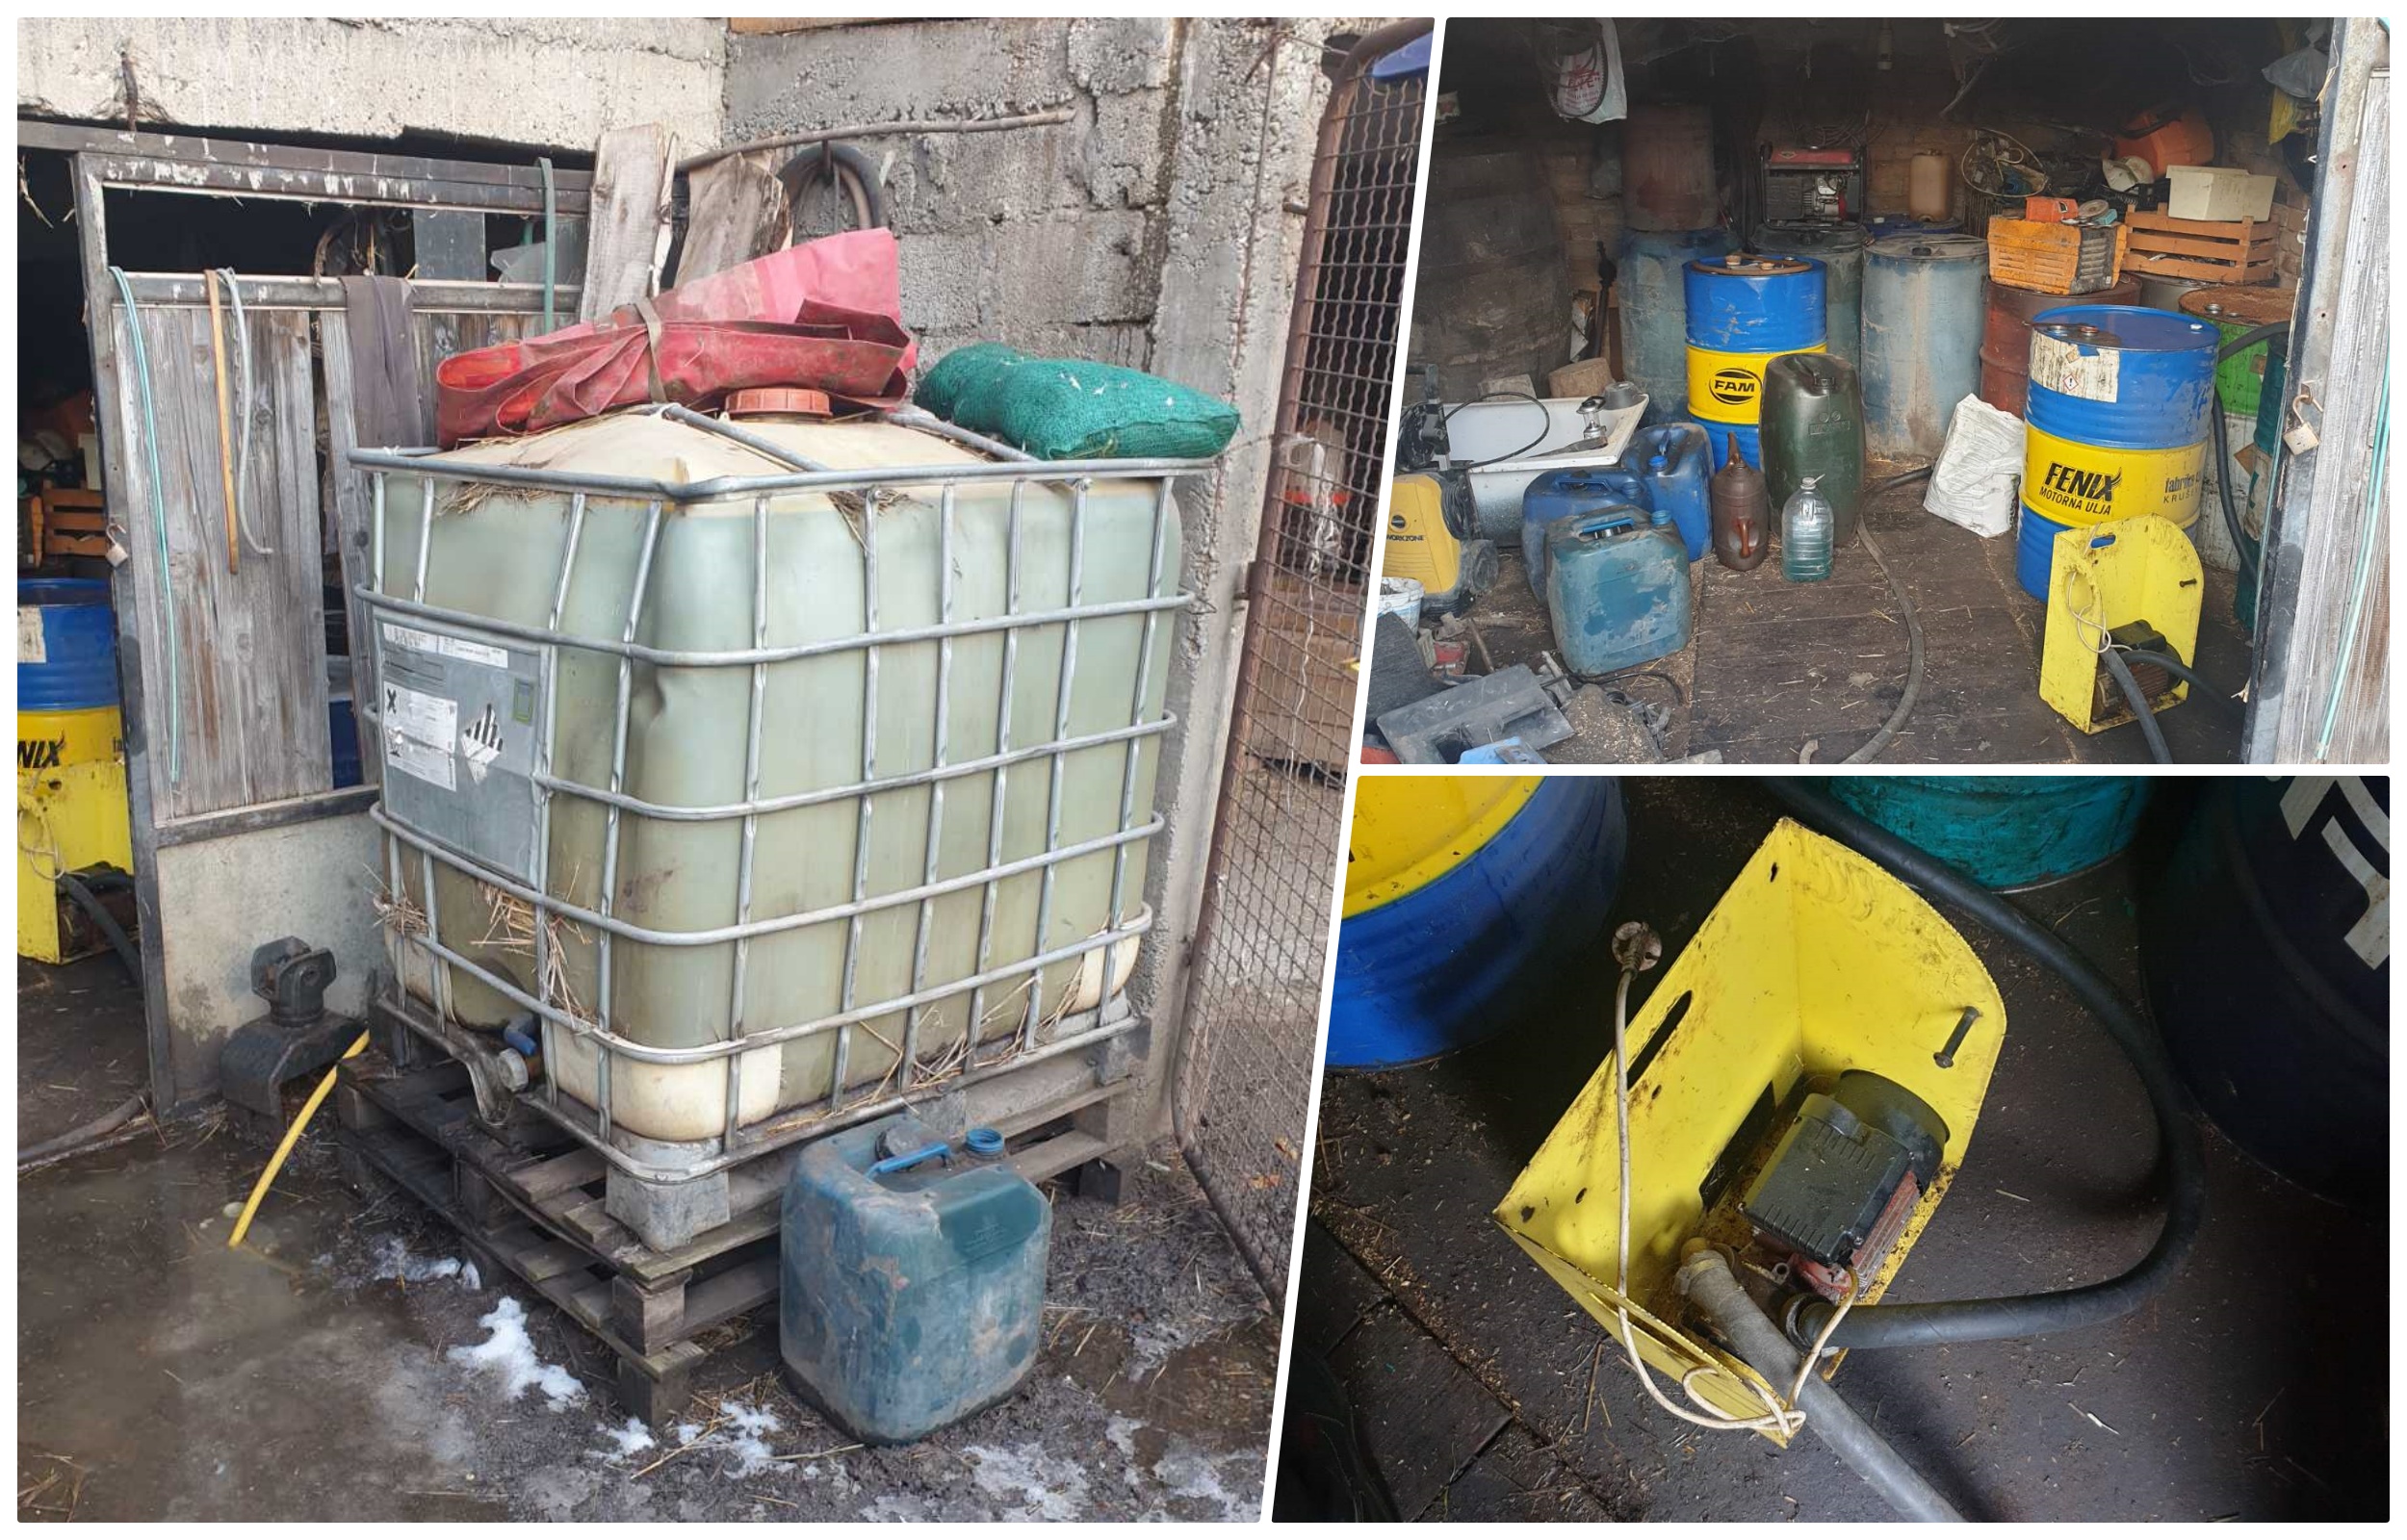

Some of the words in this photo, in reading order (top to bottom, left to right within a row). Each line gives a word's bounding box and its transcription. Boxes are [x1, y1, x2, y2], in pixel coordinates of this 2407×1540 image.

[1714, 379, 1755, 393] FAM
[2045, 462, 2119, 501] FENIX
[2039, 486, 2083, 510] MOTORNA
[2084, 501, 2111, 516] ULJA
